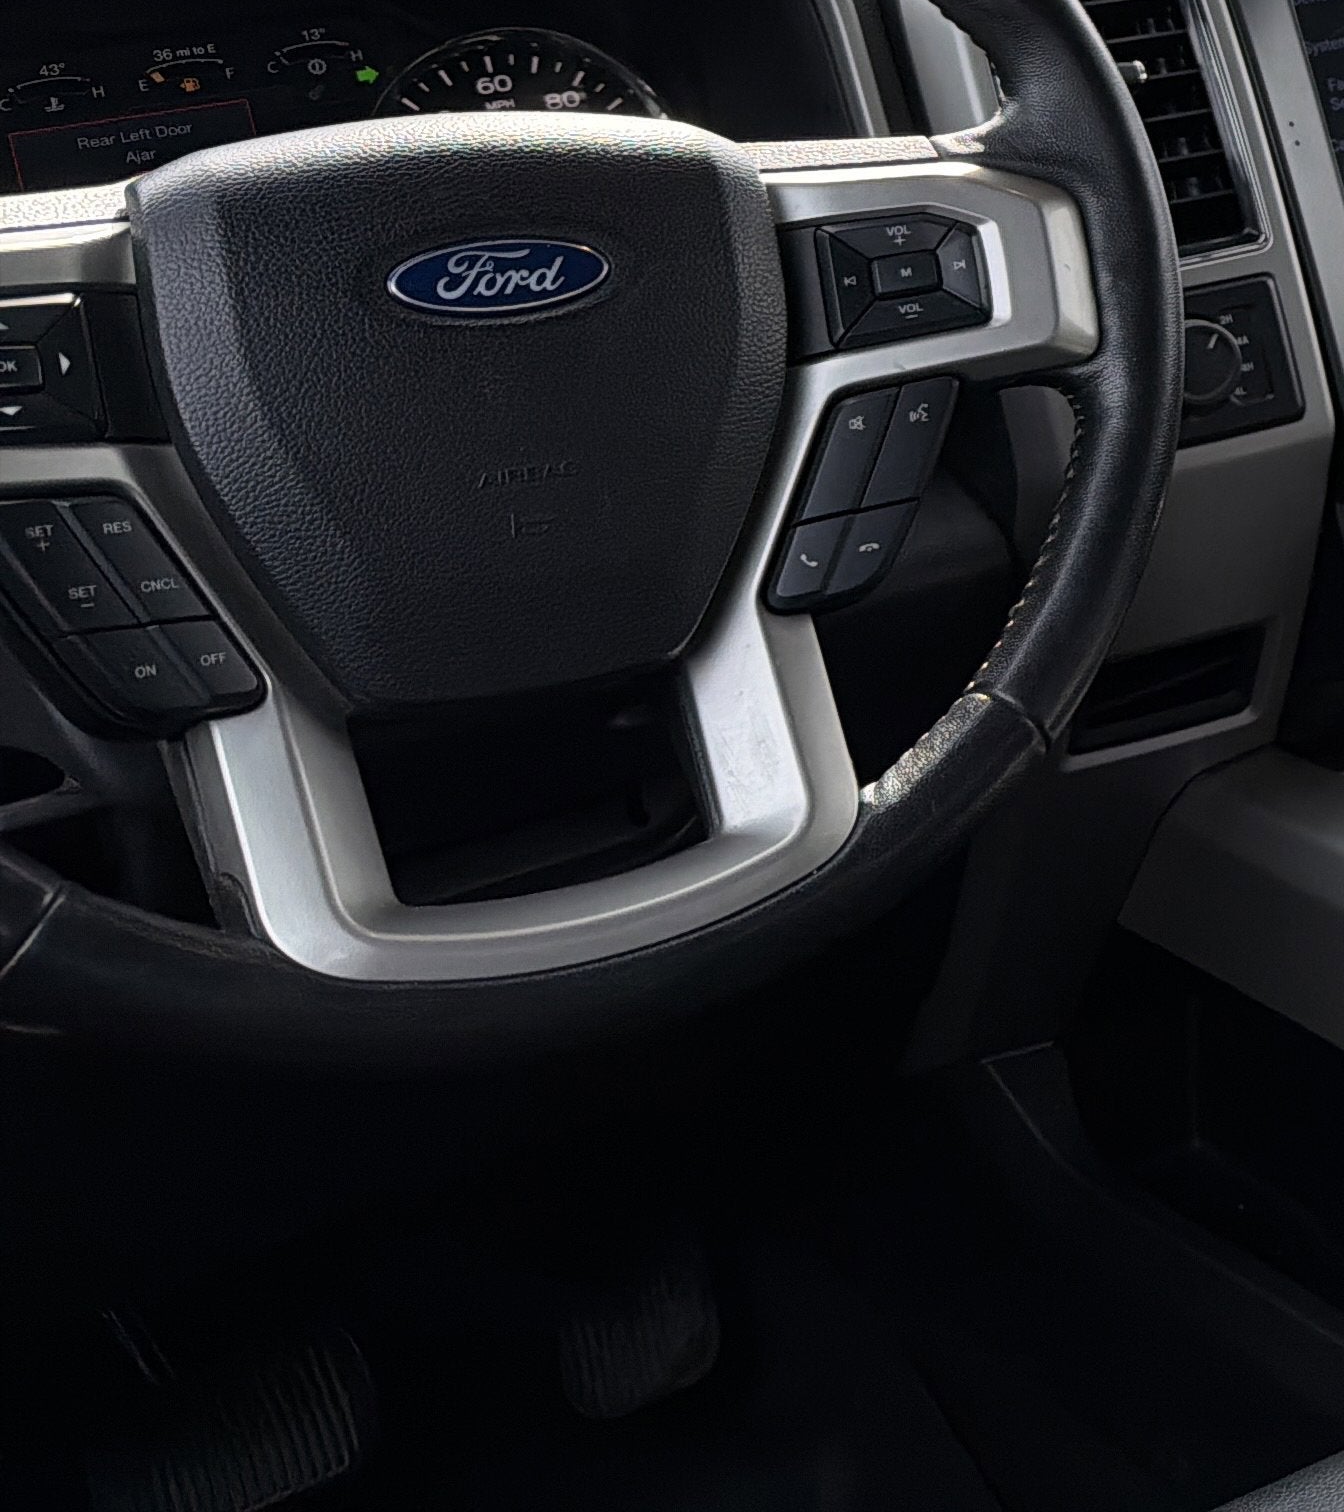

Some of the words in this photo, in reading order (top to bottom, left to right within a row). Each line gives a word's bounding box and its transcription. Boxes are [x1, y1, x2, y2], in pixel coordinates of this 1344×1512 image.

[153, 48, 173, 61] 36
[176, 46, 190, 57] mi
[193, 45, 205, 55] to
[207, 43, 216, 54] E
[475, 74, 513, 95] 60
[543, 90, 582, 110] 80
[76, 133, 116, 149] Rear
[120, 127, 152, 144] Left
[155, 122, 193, 138] Door
[125, 148, 157, 165] Ajar
[886, 224, 912, 236] VOL
[436, 248, 565, 300] Ford
[898, 302, 924, 314] VOL
[24, 524, 54, 538] SET
[103, 520, 133, 535] RES
[68, 586, 97, 600] SET
[140, 578, 179, 593] CNCL
[200, 651, 227, 666] OFF
[134, 665, 157, 679] ON
